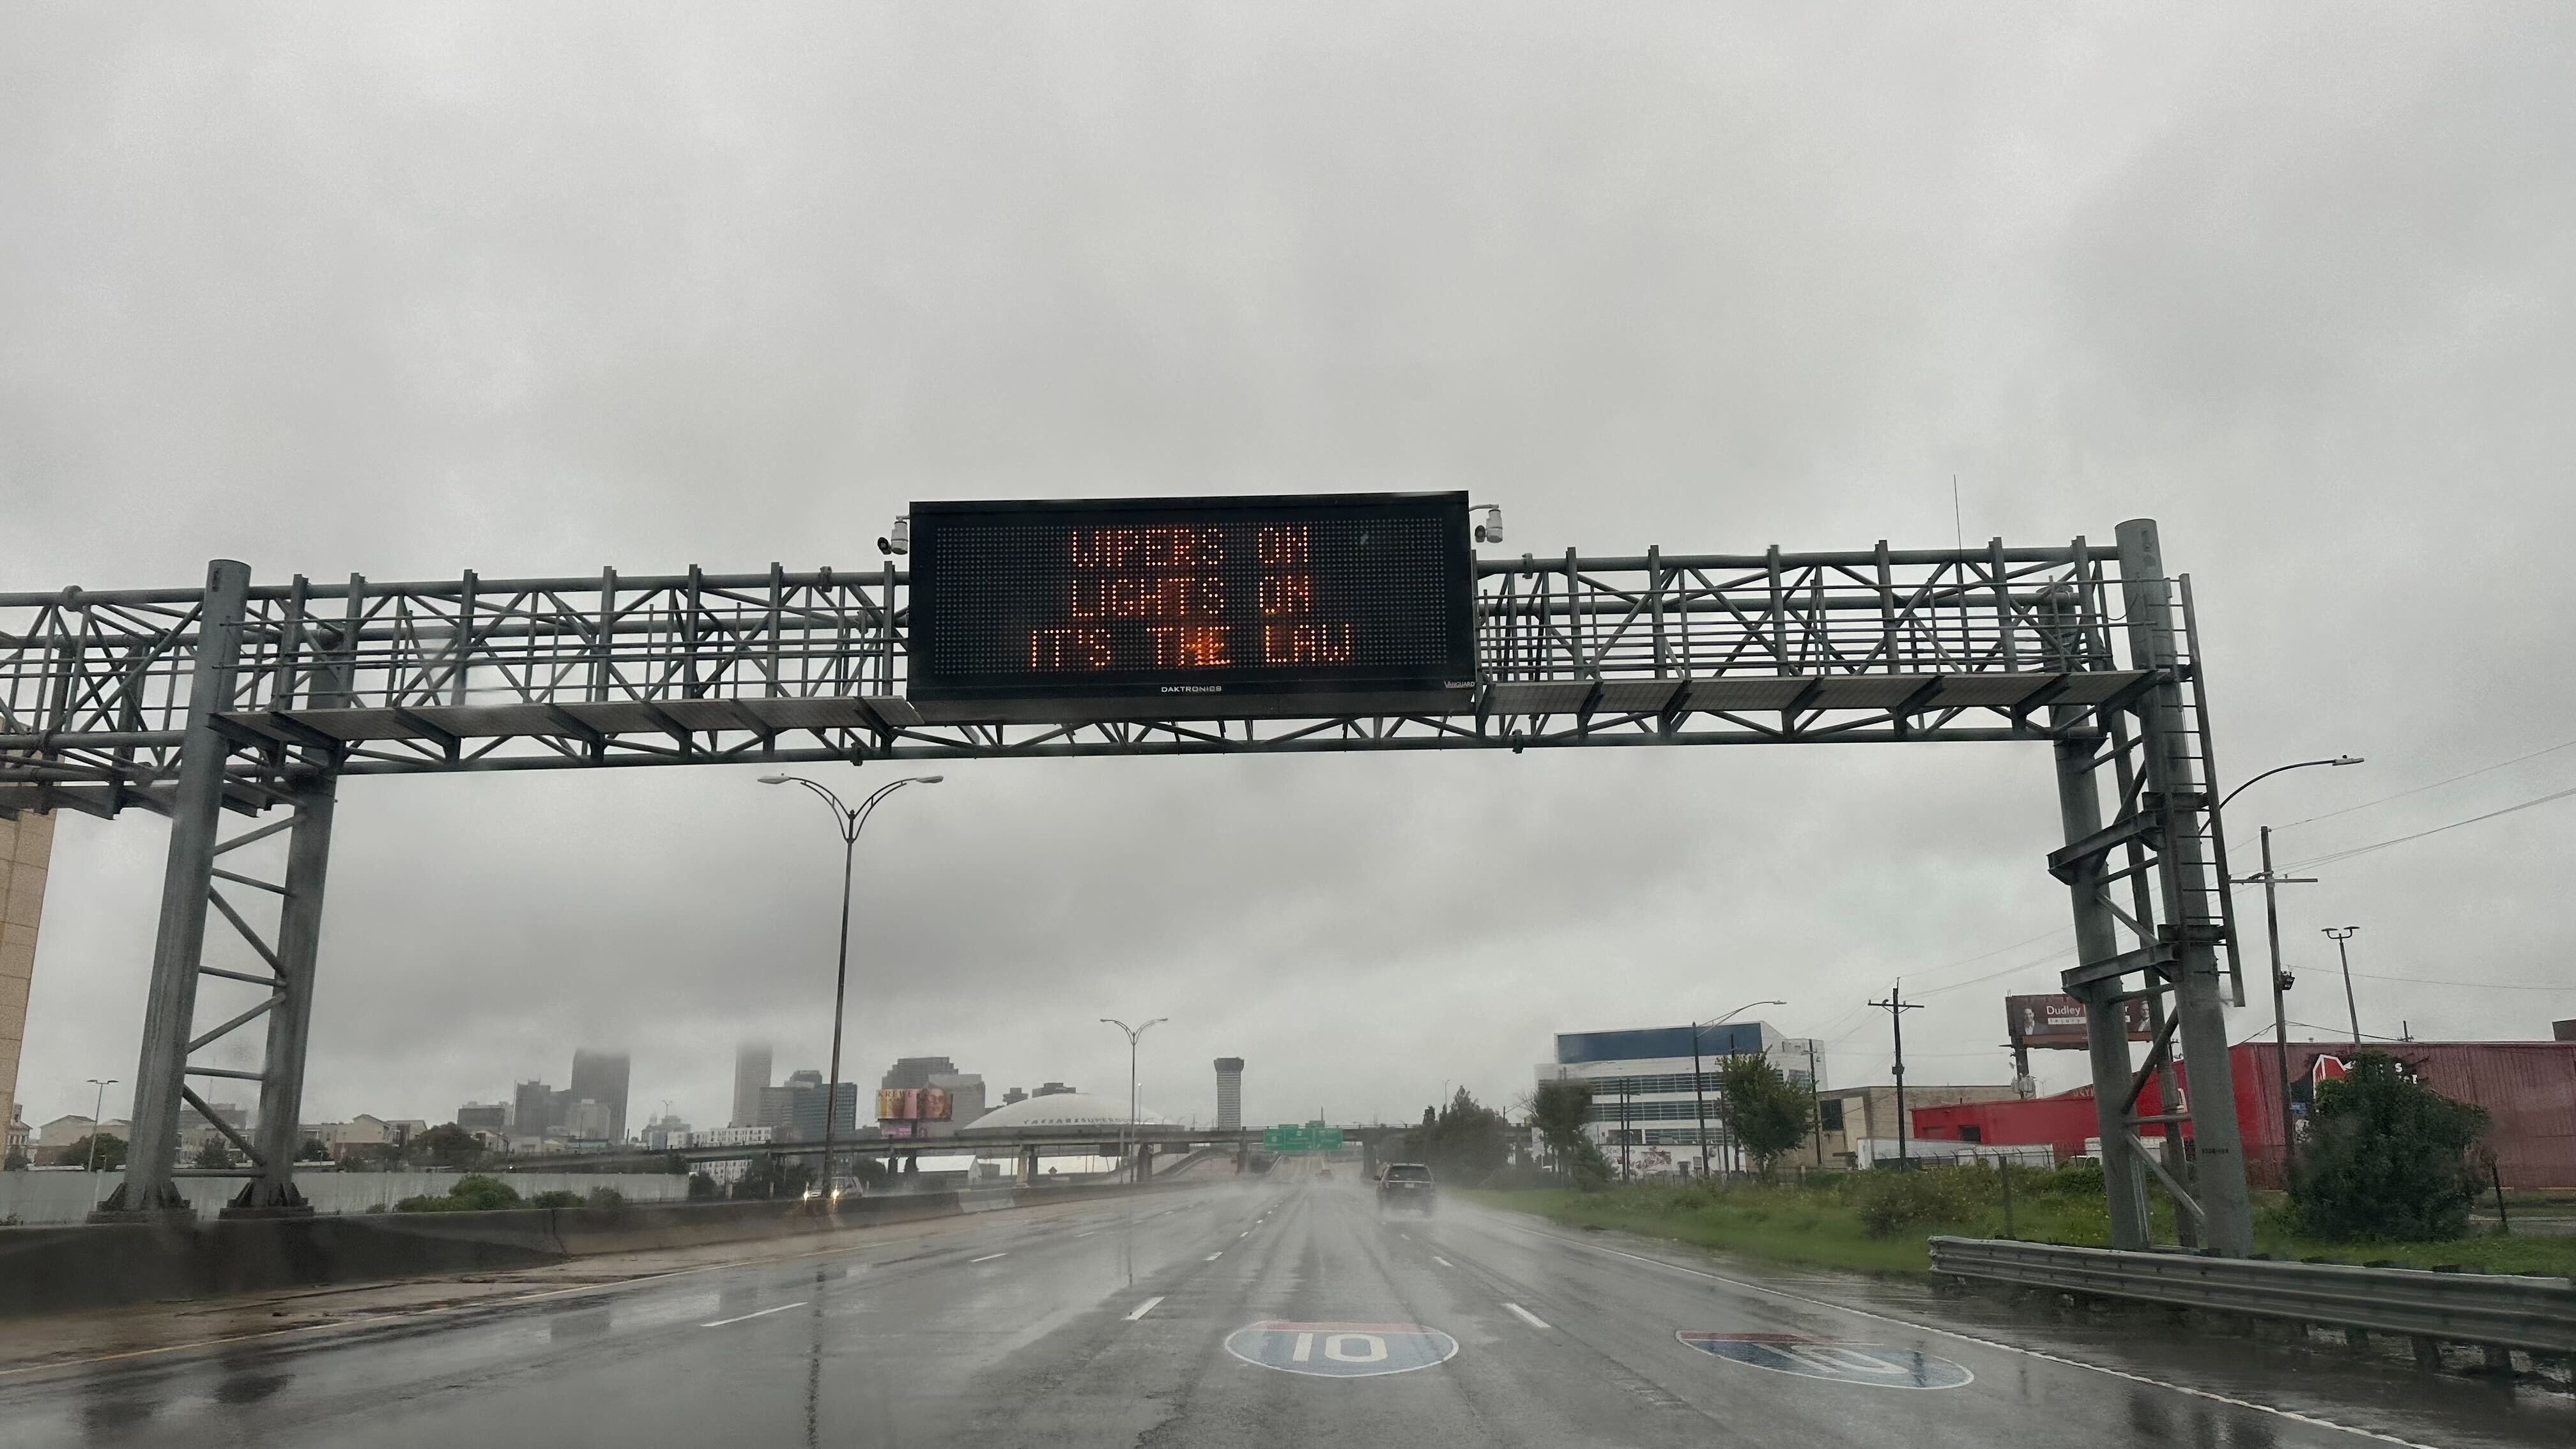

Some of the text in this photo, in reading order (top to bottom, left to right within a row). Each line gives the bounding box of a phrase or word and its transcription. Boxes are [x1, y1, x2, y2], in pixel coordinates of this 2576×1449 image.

[1072, 526, 1308, 568] WIPERS ON
[1072, 575, 1309, 617] LIGHTS ON
[1032, 623, 1350, 668] IT'S THE LAW
[2046, 1005, 2081, 1016] Dudley
[1292, 1332, 1388, 1363] 10
